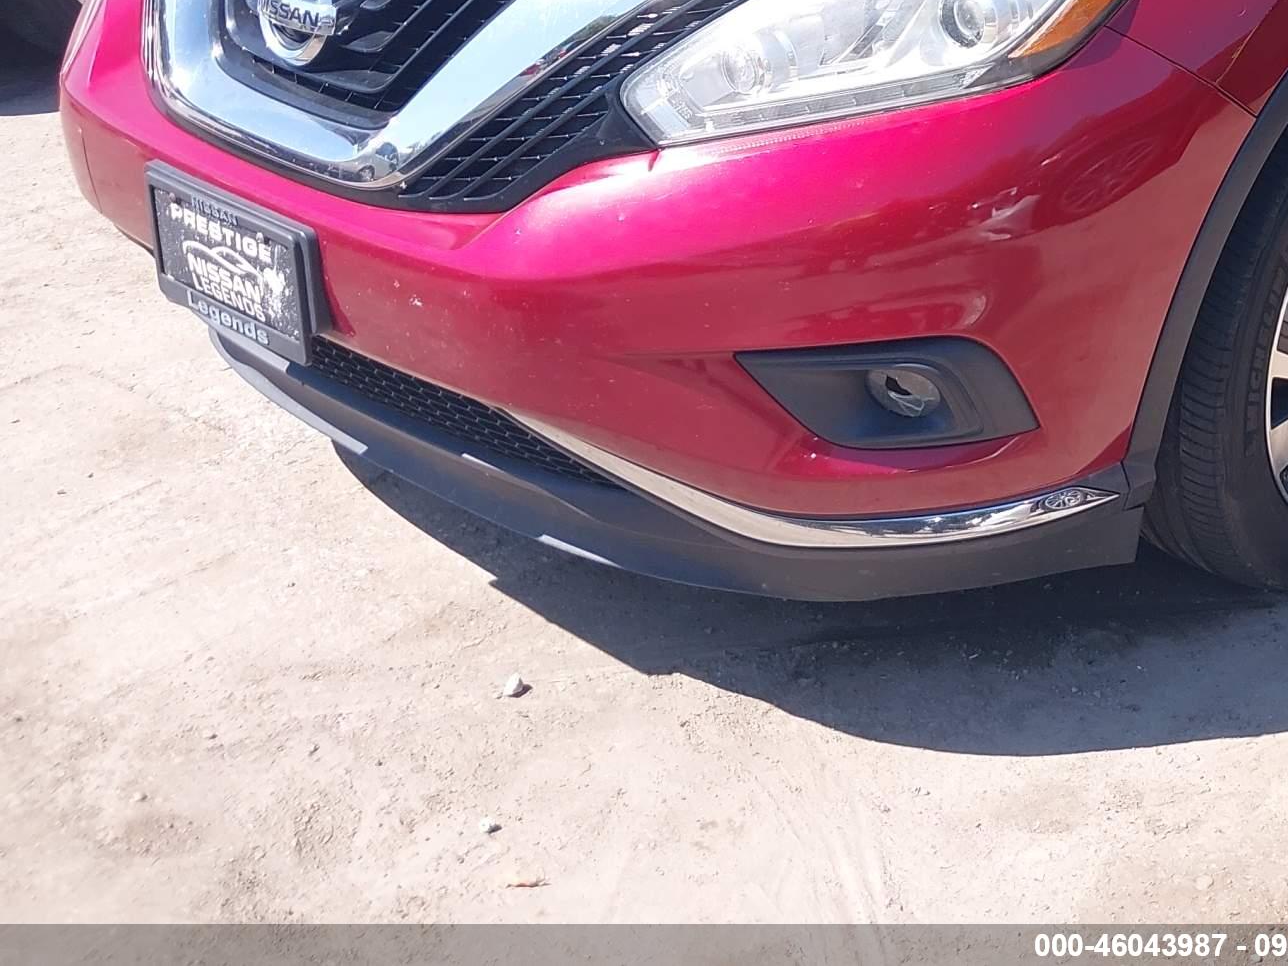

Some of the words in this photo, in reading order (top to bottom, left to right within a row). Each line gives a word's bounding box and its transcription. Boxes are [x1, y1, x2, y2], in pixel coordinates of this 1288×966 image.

[169, 202, 273, 263] PRESTIGE
[187, 253, 265, 306] NISSAN
[191, 272, 266, 323] LEGENDS
[187, 289, 270, 346] Legends
